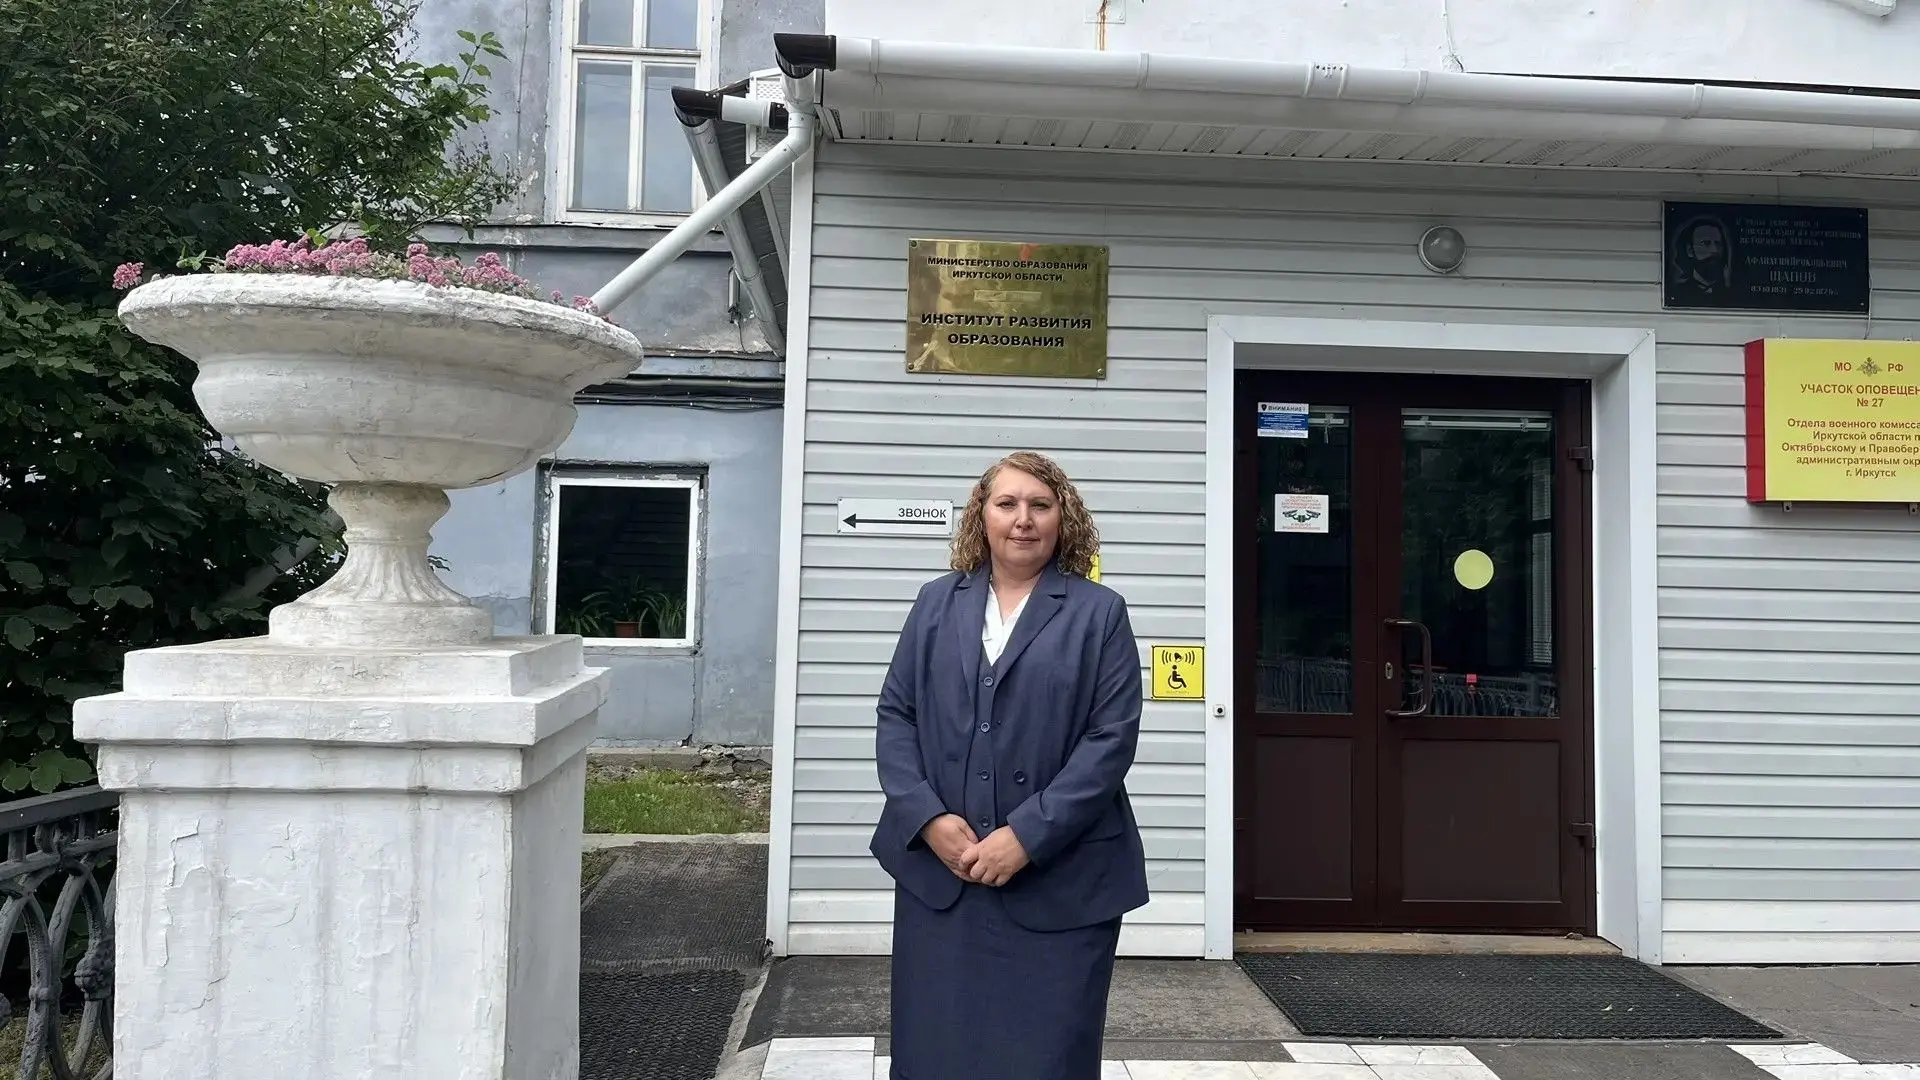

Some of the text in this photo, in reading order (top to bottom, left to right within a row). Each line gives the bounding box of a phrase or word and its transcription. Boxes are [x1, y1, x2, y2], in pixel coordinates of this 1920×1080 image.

[927, 256, 1088, 270] МИНИСТЕРСТВО ОБРАЗОВАНИЯ
[952, 270, 1012, 280] ИРКУТСКОЙ
[921, 313, 1092, 329] ИНСТИТУТ РАЗВИТИЯ
[947, 333, 1065, 347] ОБРАЗОВАНИЯ
[1834, 362, 1904, 372] МО РФ
[1800, 384, 1853, 394] УЧАСТОК
[1857, 398, 1884, 407] № 27
[1787, 418, 1826, 428] Отдела
[1829, 420, 1877, 429] военного
[1813, 431, 1867, 441] Иркутской
[1869, 432, 1911, 441] области
[1781, 442, 1857, 454] Октябрьскому
[1796, 456, 1900, 466] административным
[1855, 468, 1897, 479] Иркутск
[898, 507, 947, 518] ЗВОНОК
